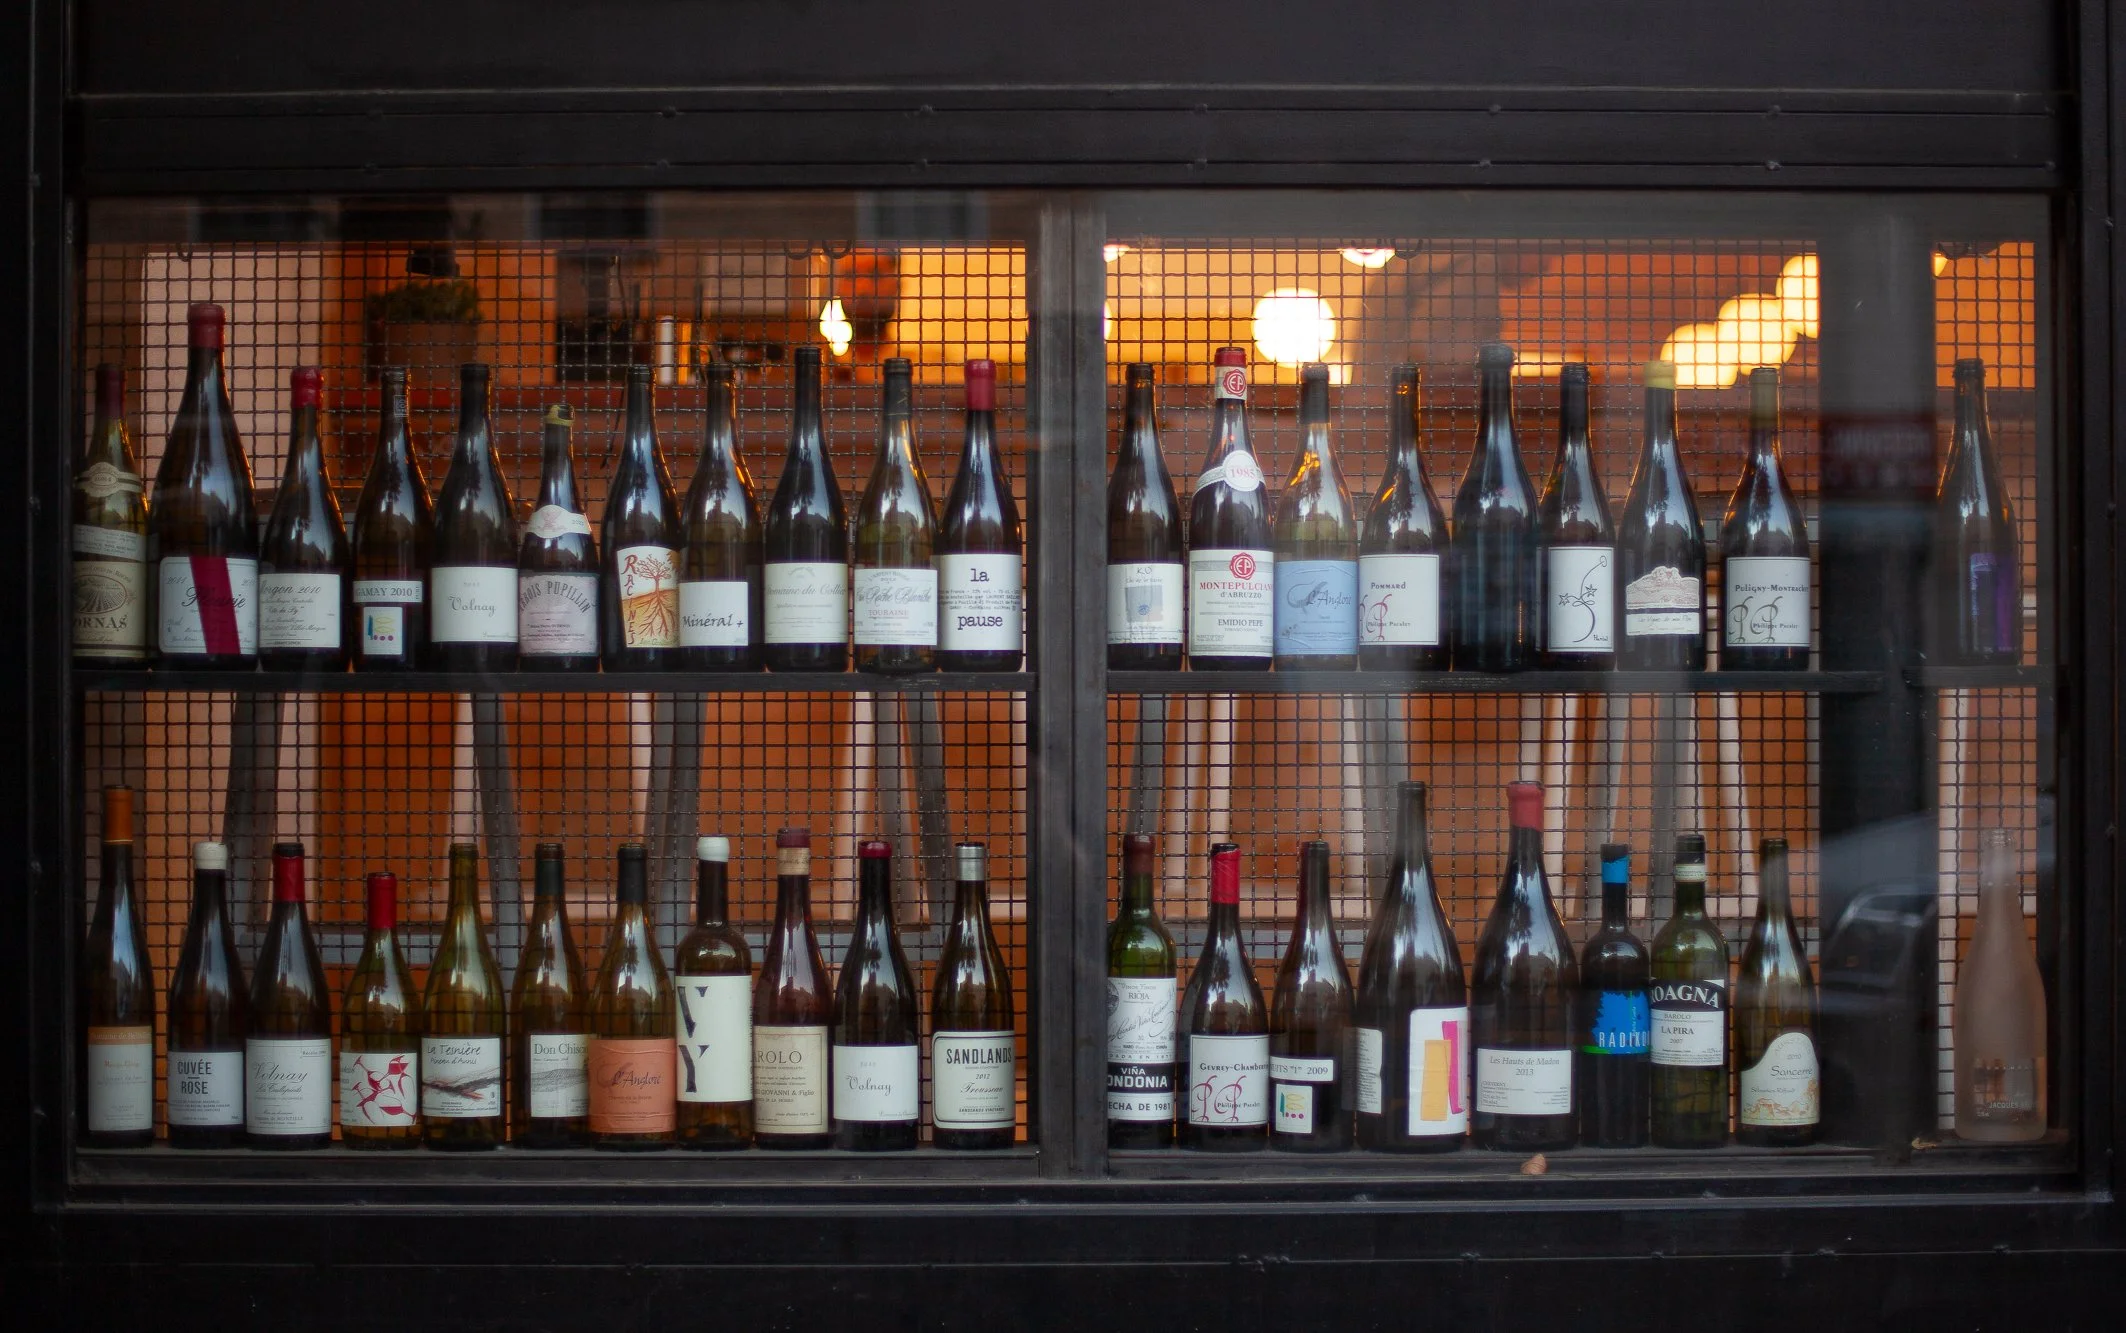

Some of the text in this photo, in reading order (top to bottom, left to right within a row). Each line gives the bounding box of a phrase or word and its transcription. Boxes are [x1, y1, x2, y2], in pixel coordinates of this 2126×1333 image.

[969, 567, 990, 583] la
[261, 579, 294, 595] orgon
[390, 587, 413, 598] 2010
[1199, 581, 1273, 591] MONTEPULCIAN
[546, 580, 592, 614] PUPILLIN
[448, 596, 496, 617] Volnay
[681, 613, 734, 628] Minéral
[957, 614, 1004, 631] pause
[1217, 618, 1264, 627] EMIDIO PEPE
[1128, 992, 1150, 1001] RIOJA
[1660, 1026, 1695, 1036] LA PIRA
[533, 1042, 556, 1055] Don
[753, 1050, 802, 1064] ROLO
[945, 1047, 1012, 1065] SANDLANDS
[1489, 1055, 1501, 1065] Les
[1502, 1056, 1525, 1066] Hauts
[1525, 1057, 1535, 1066] de
[176, 1058, 213, 1075] CUVÉE
[253, 1061, 308, 1084] Volnay
[1121, 1065, 1147, 1076] VIÑA
[1306, 1066, 1329, 1076] 2009
[1515, 1068, 1534, 1077] 2013
[1770, 1065, 1813, 1077] Sancerre
[180, 1081, 209, 1095] ROSE
[845, 1075, 892, 1097] Volnay
[1107, 1075, 1168, 1089] ONDONIA
[1108, 1101, 1171, 1112] ECHA DE 1981
